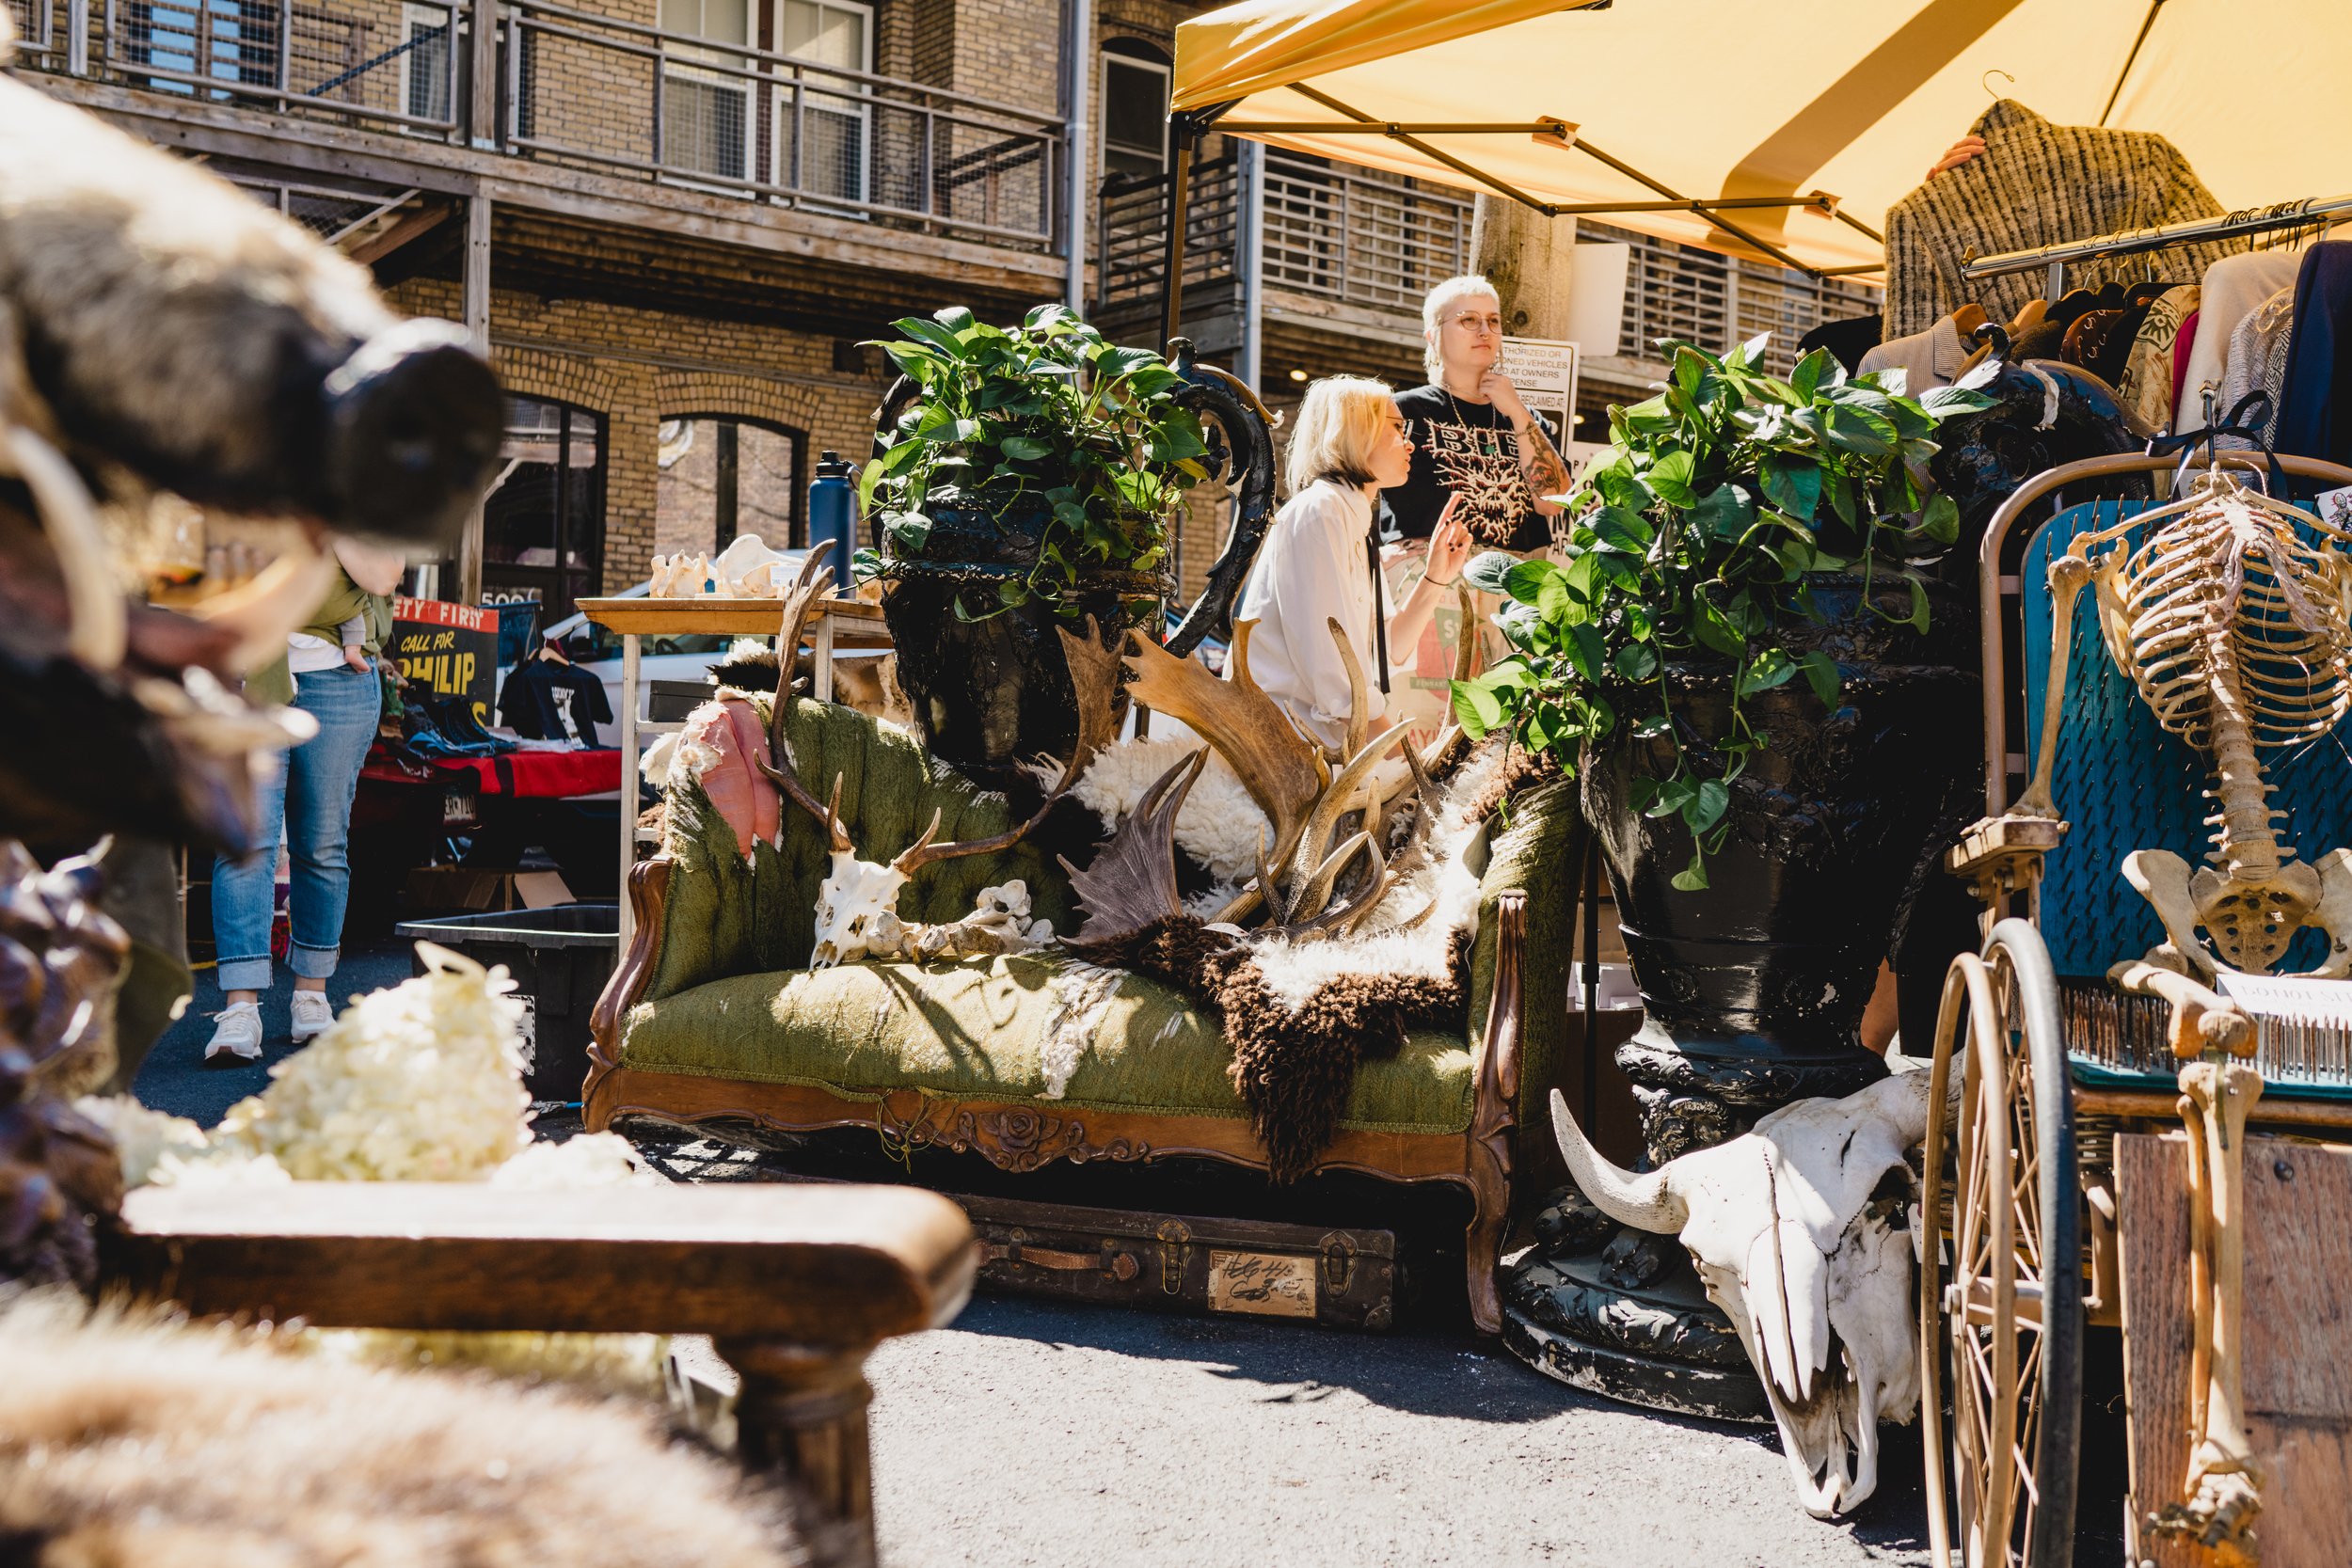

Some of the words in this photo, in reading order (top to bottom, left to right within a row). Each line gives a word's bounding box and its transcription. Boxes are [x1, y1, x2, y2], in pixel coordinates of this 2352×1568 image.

[1504, 346, 1546, 357] THORIZED
[1526, 359, 1568, 370] VEHICLES
[1521, 368, 1560, 379] OWNERS
[1510, 378, 1538, 388] PENSE
[1520, 394, 1556, 407] RECLAIMED
[392, 597, 425, 620] ETY
[439, 603, 485, 630] FIRST
[400, 633, 431, 653] CALL
[433, 630, 455, 651] FOR
